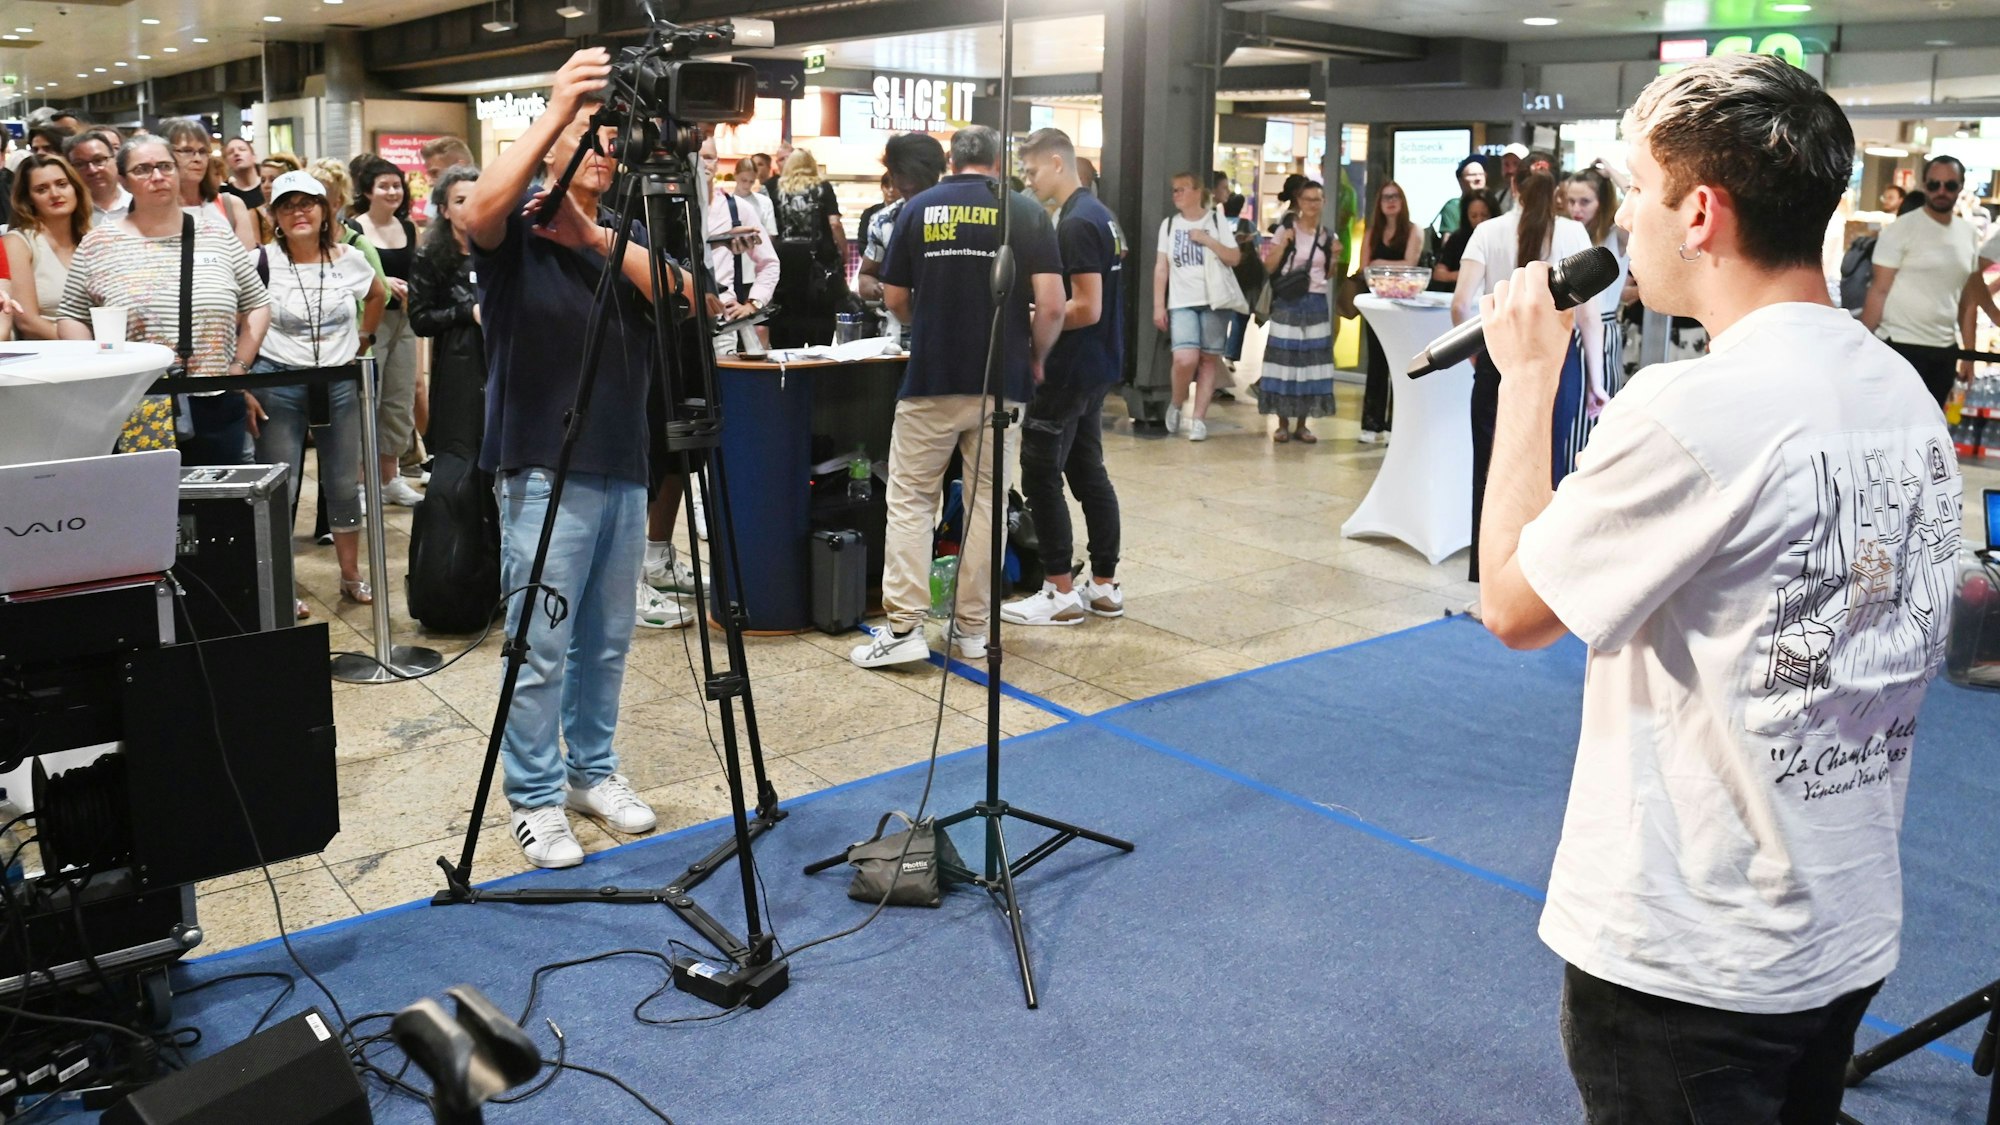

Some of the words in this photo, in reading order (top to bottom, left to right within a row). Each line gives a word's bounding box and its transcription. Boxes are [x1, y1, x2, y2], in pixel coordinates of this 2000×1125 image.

[872, 75, 947, 121] SLICE
[951, 82, 977, 122] IT
[924, 222, 957, 243] BASE
[924, 248, 998, 258] www.talentbase.d
[3, 517, 86, 537] VAIO
[1804, 772, 1857, 801] Vincent
